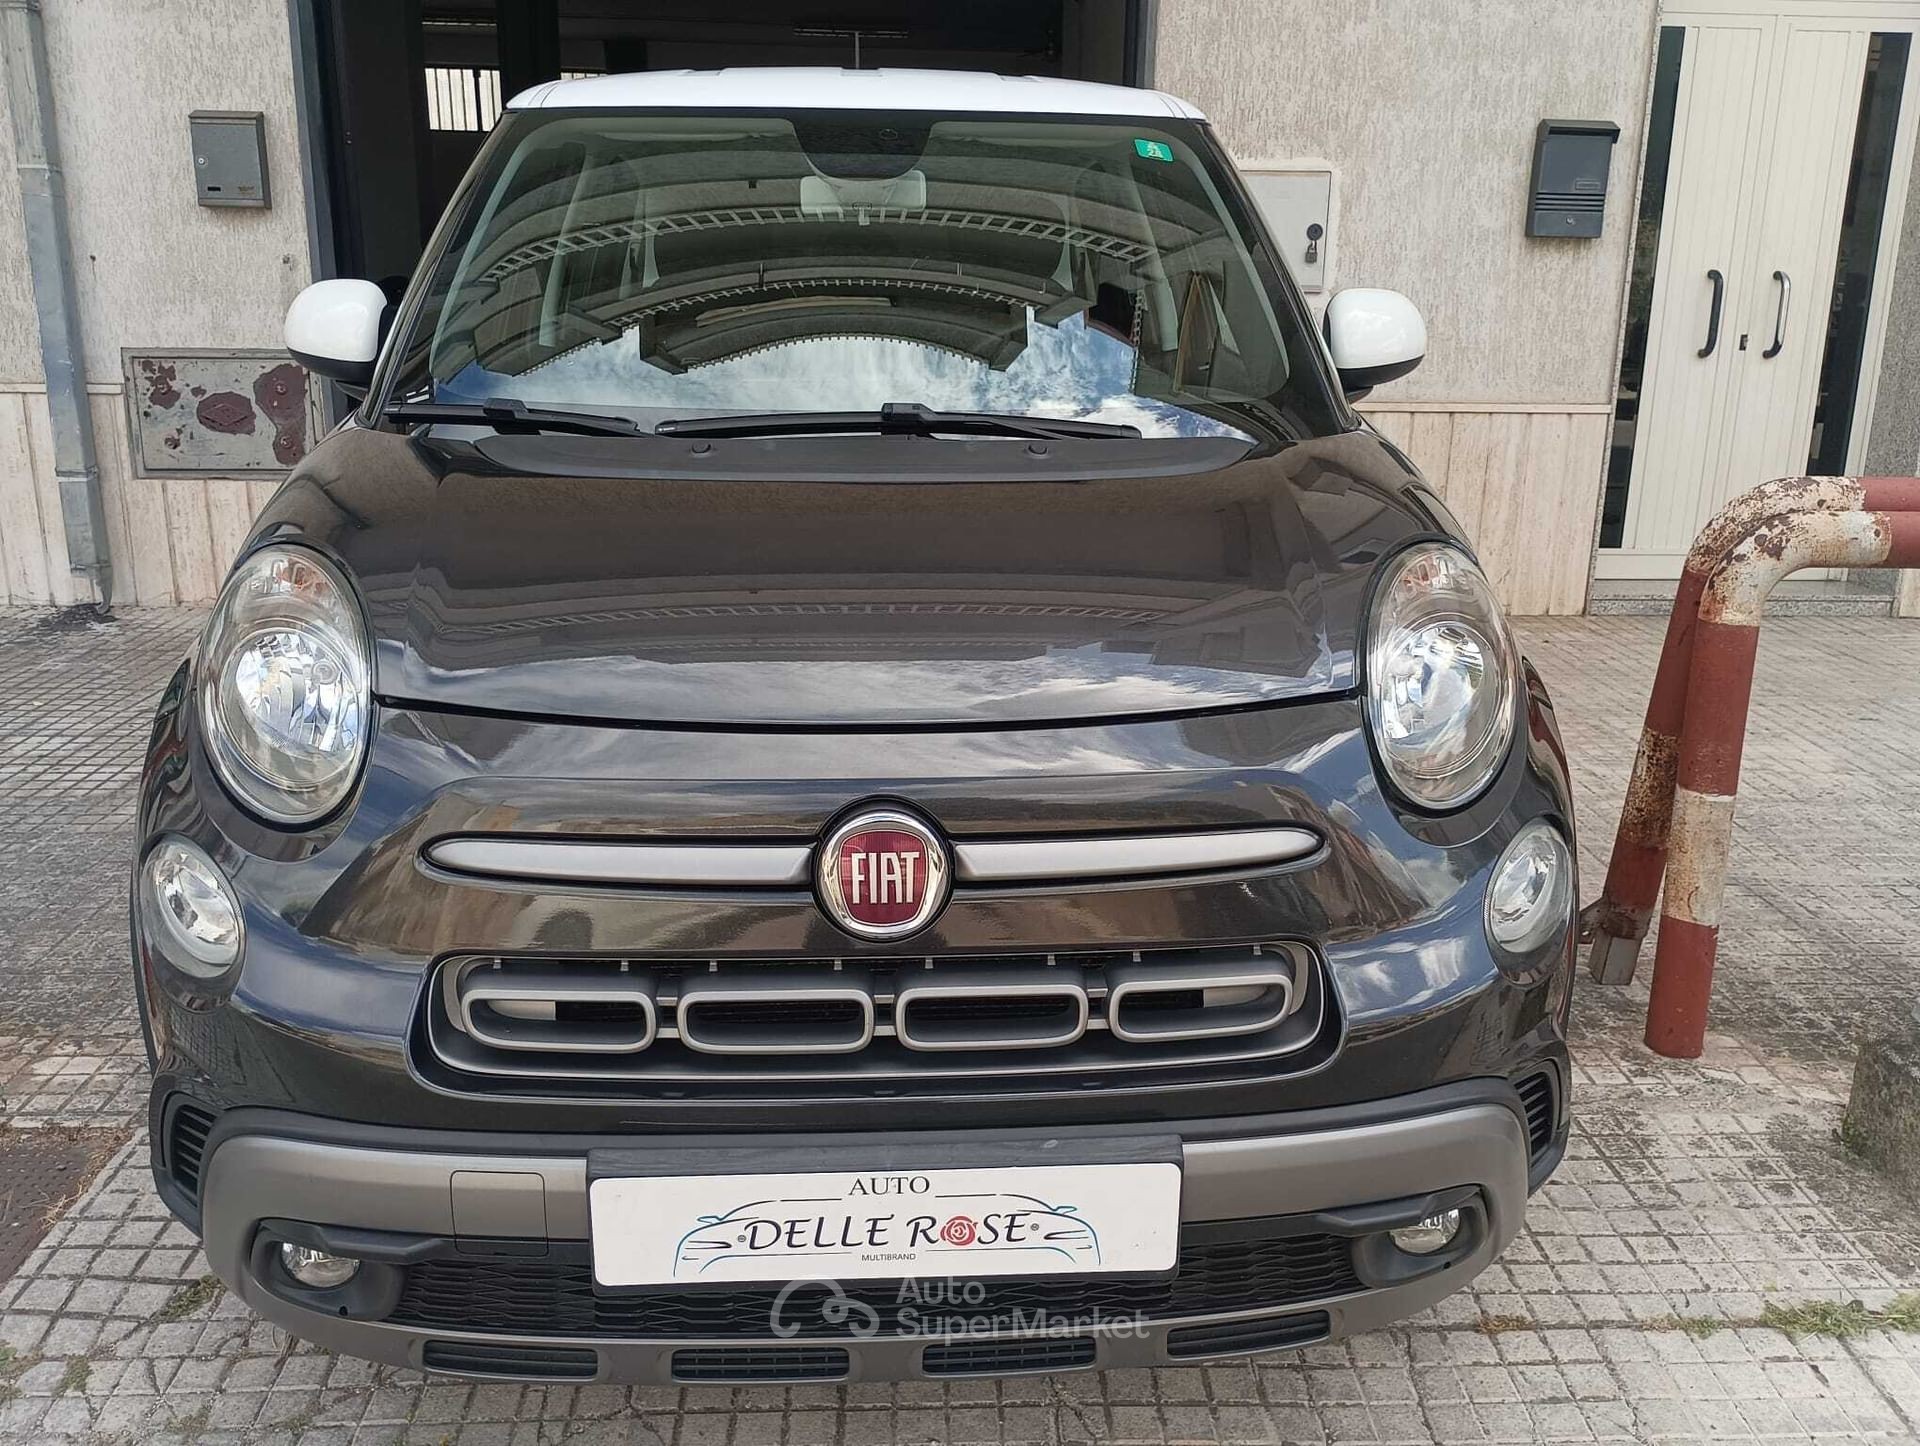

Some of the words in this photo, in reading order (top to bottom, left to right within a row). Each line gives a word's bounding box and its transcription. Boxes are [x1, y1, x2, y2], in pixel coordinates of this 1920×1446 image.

[851, 851, 920, 904] FIAT
[849, 1176, 930, 1195] AUTO
[744, 1214, 895, 1250] DELLE
[861, 1253, 917, 1262] MULTIBRAND
